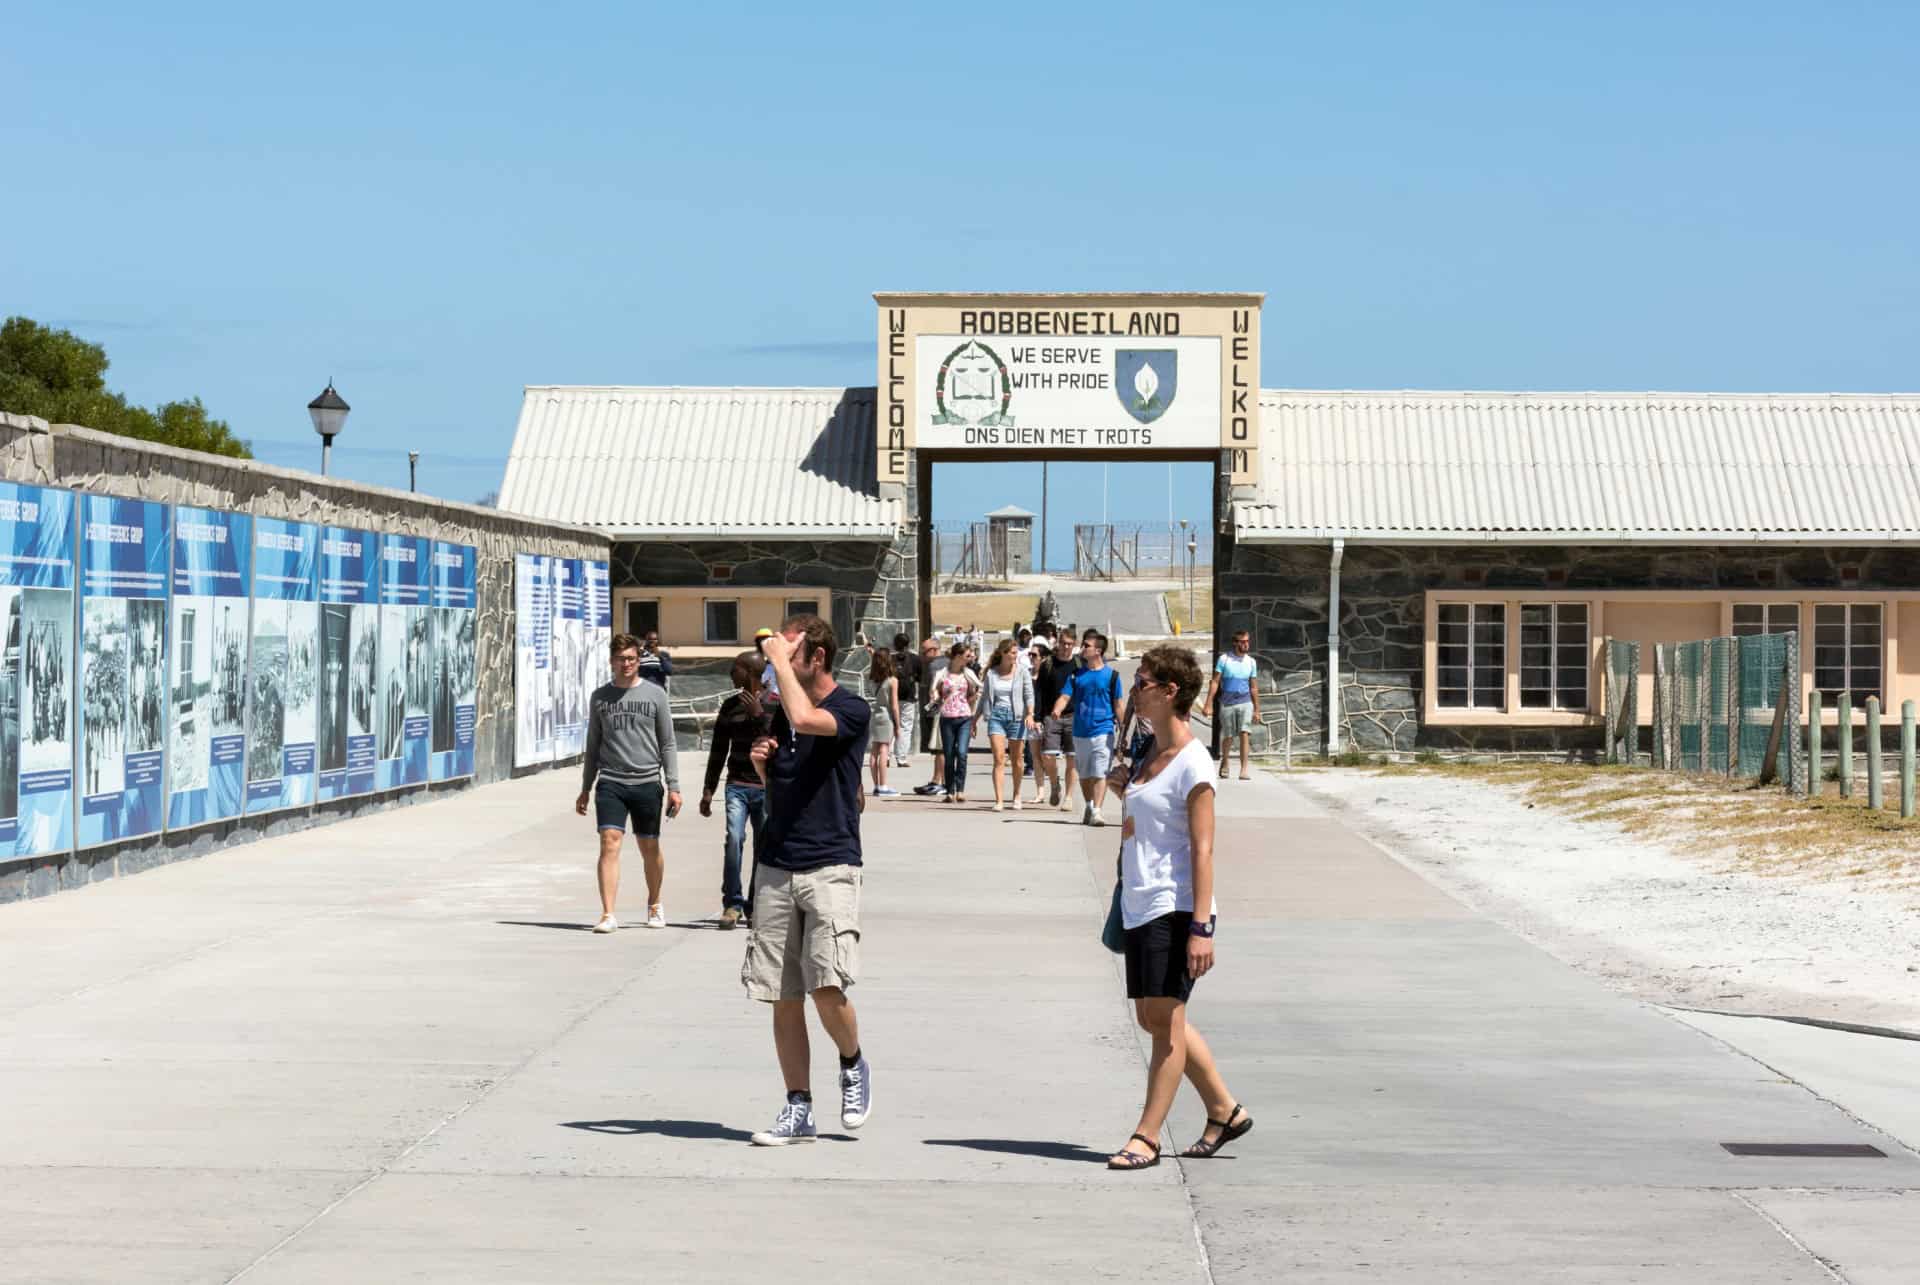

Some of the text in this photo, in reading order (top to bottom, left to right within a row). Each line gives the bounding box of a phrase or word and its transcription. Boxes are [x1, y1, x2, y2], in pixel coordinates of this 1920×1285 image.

[960, 311, 1180, 335] ROBBENEILAND
[1011, 347, 1102, 364] WE SERVE
[1011, 373, 1109, 389] WITH PRIDE
[888, 309, 905, 475] WELCOME
[1231, 310, 1249, 473] WELKOM
[964, 427, 1152, 444] ONS DIEN MET TROTS
[613, 714, 636, 730] CITY
